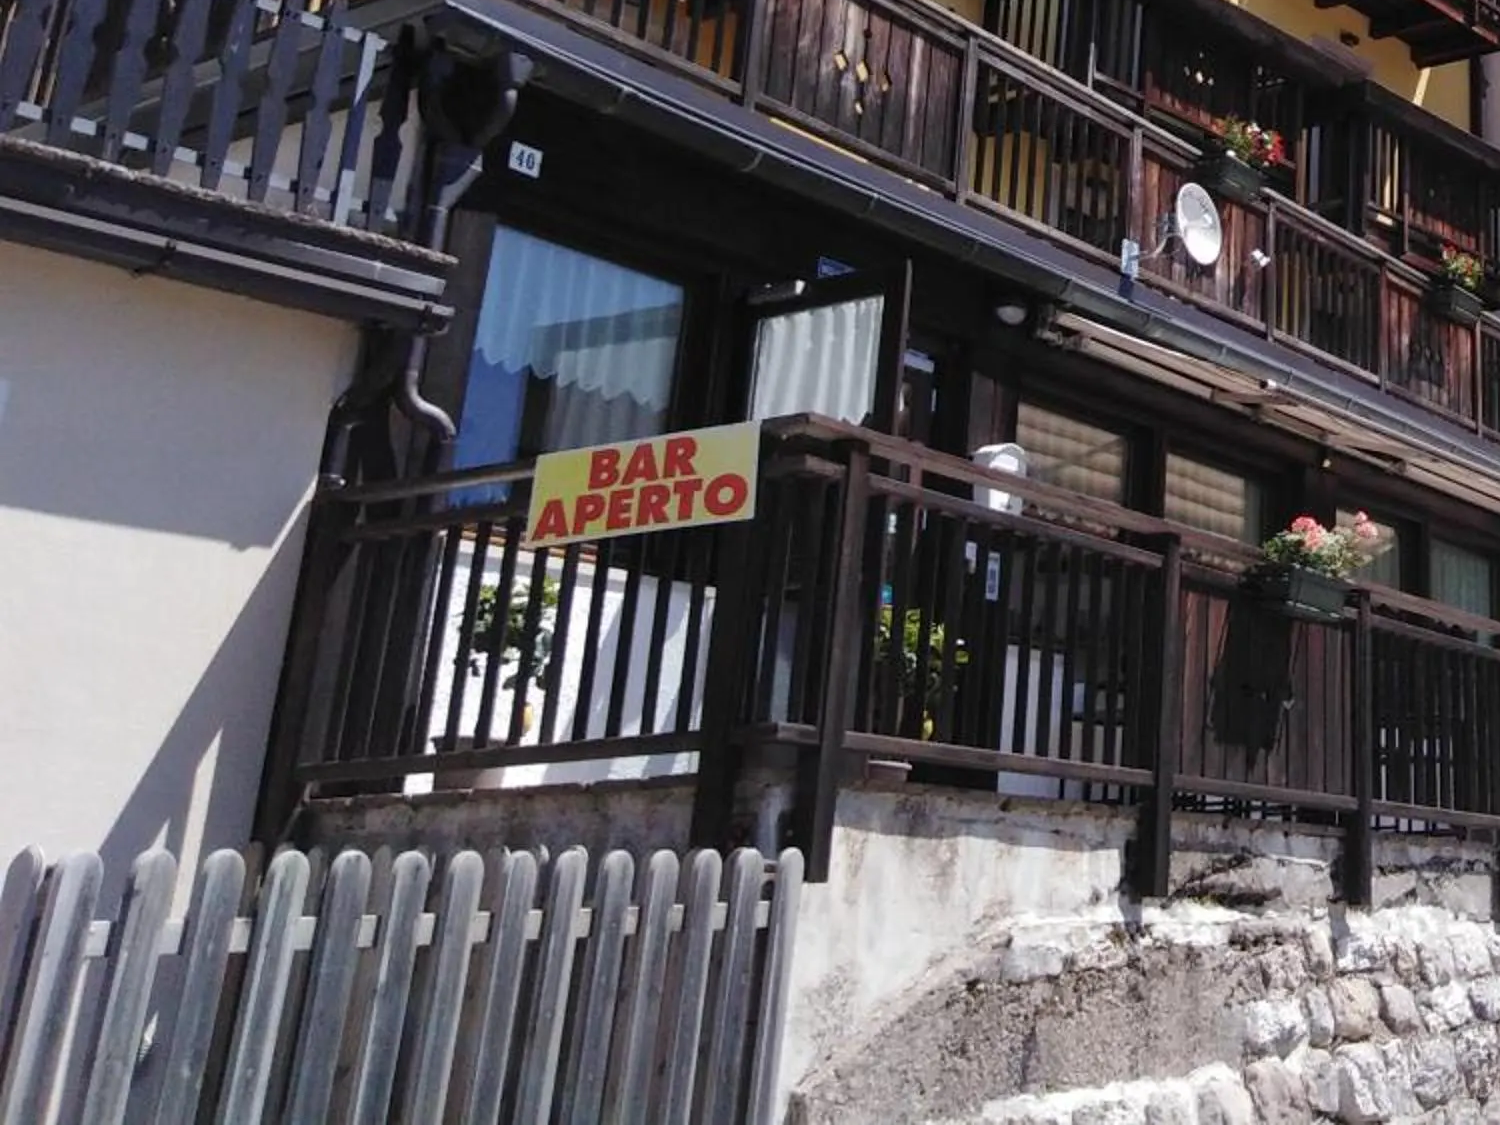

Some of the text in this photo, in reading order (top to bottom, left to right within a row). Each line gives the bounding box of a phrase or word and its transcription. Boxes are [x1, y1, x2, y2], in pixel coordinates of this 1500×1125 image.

[515, 149, 535, 171] 40
[588, 436, 698, 490] BAR
[532, 473, 748, 541] APERTO
